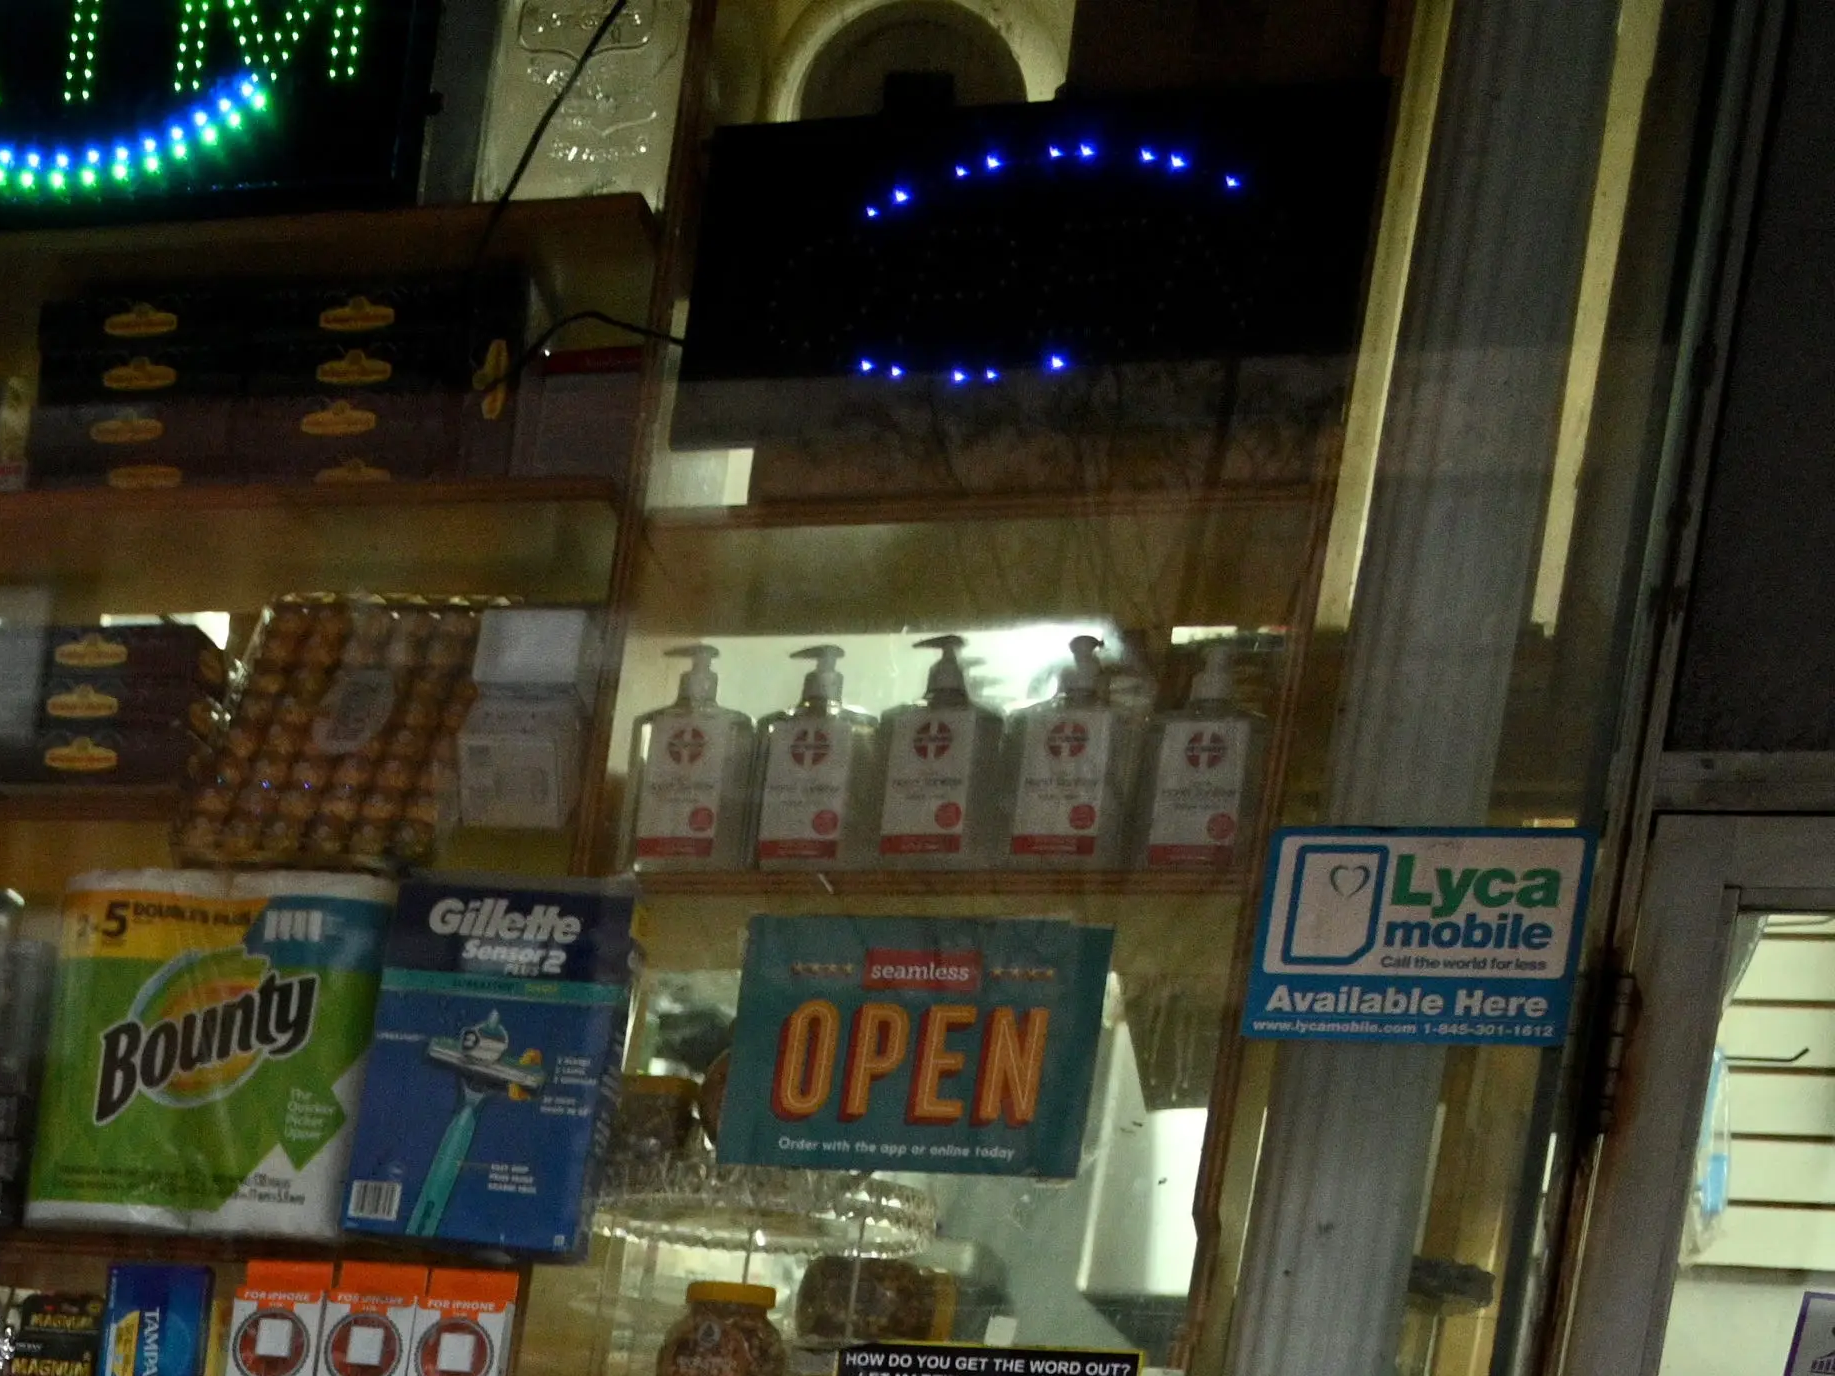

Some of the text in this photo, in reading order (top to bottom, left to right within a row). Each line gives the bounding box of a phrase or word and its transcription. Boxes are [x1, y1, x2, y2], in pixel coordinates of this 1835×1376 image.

[1390, 853, 1562, 919] Lyca
[102, 901, 131, 940] 5
[428, 897, 583, 945] Gillette
[1382, 911, 1554, 951] mobile
[870, 962, 971, 982] seamless
[1379, 954, 1548, 973] Call the world for less
[1264, 983, 1550, 1019] Available Here
[1252, 1017, 1417, 1036] www.lycamobile.com
[93, 969, 321, 1126] Bounty
[771, 998, 1052, 1130] OPEN
[778, 1135, 1015, 1162] Order with the app or online today
[243, 1290, 312, 1303] FOR iPHONE
[427, 1300, 496, 1312] FOR iPHONE
[845, 1352, 1131, 1376] HOW DO YOU GET THE WORD OUT?
